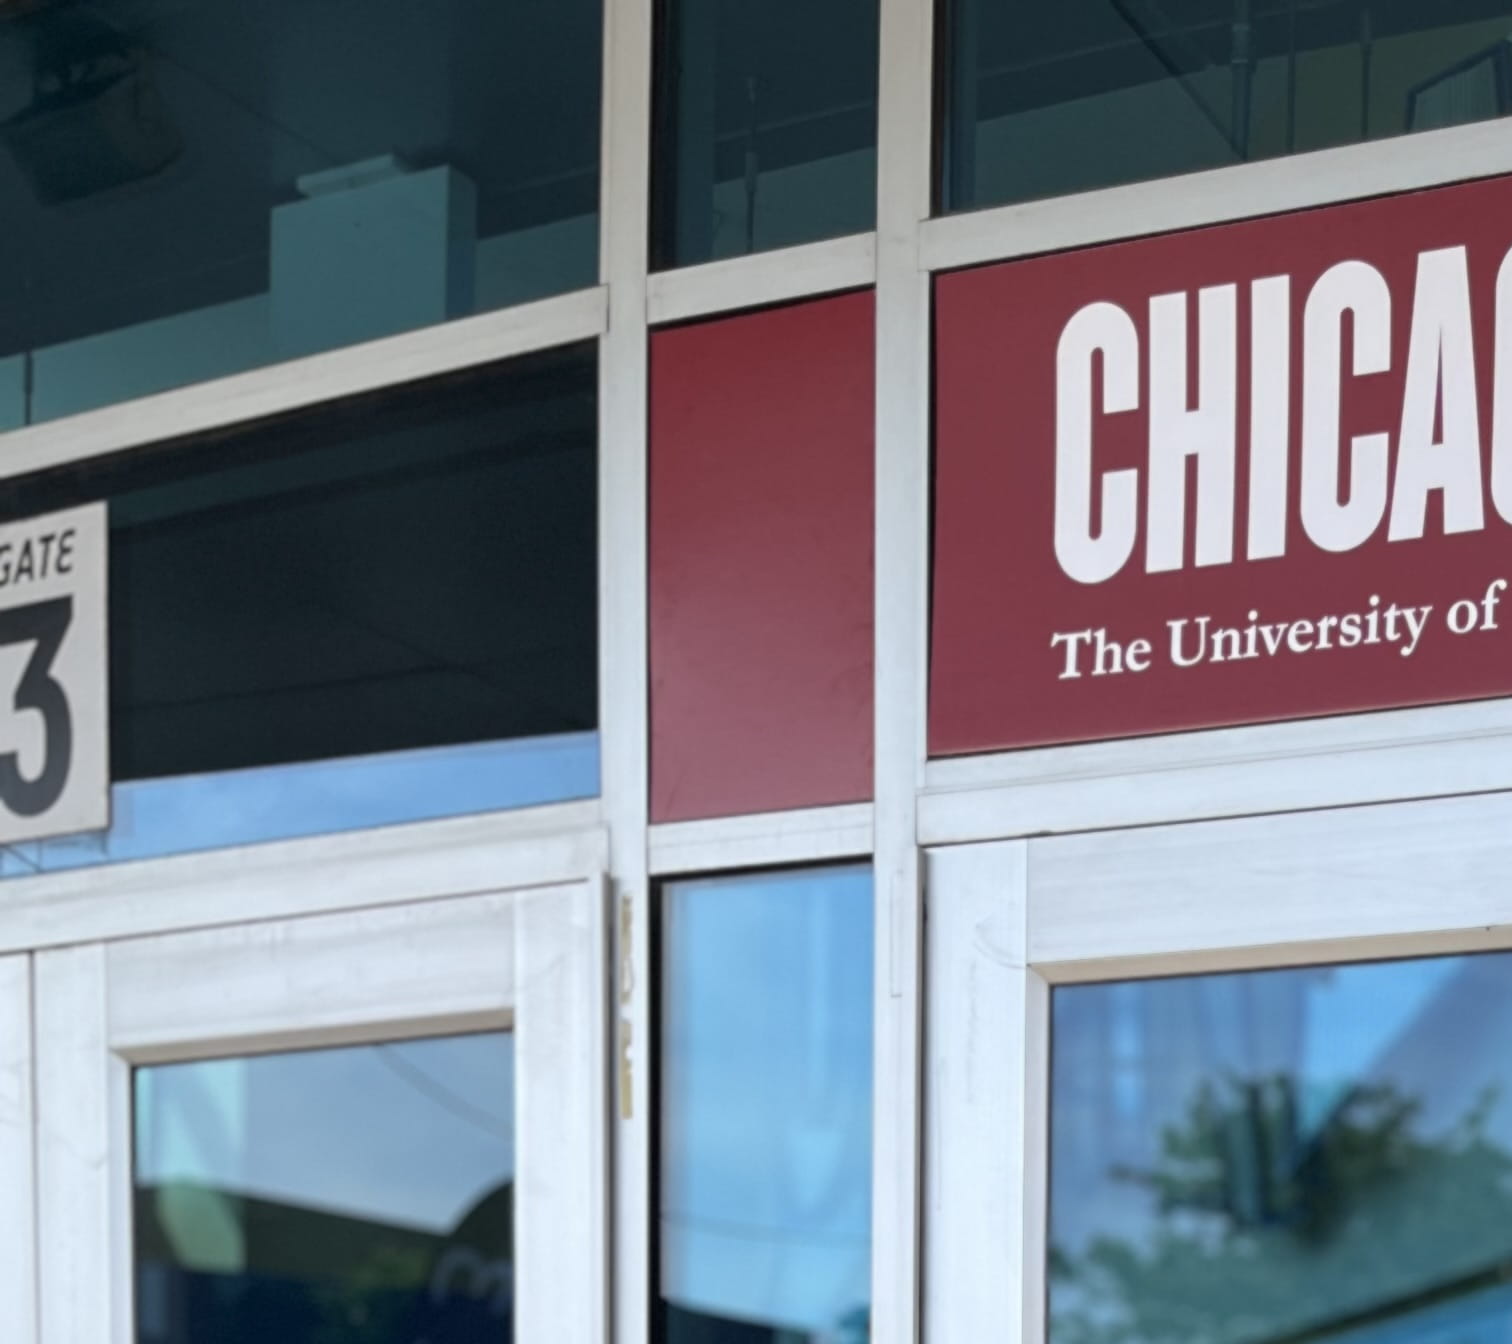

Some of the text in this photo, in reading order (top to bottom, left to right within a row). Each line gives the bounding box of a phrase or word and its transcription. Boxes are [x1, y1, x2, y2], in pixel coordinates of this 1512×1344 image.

[0, 594, 72, 819] 3
[1051, 626, 1152, 679] The
[1166, 594, 1433, 667] University
[1446, 578, 1508, 634] of
